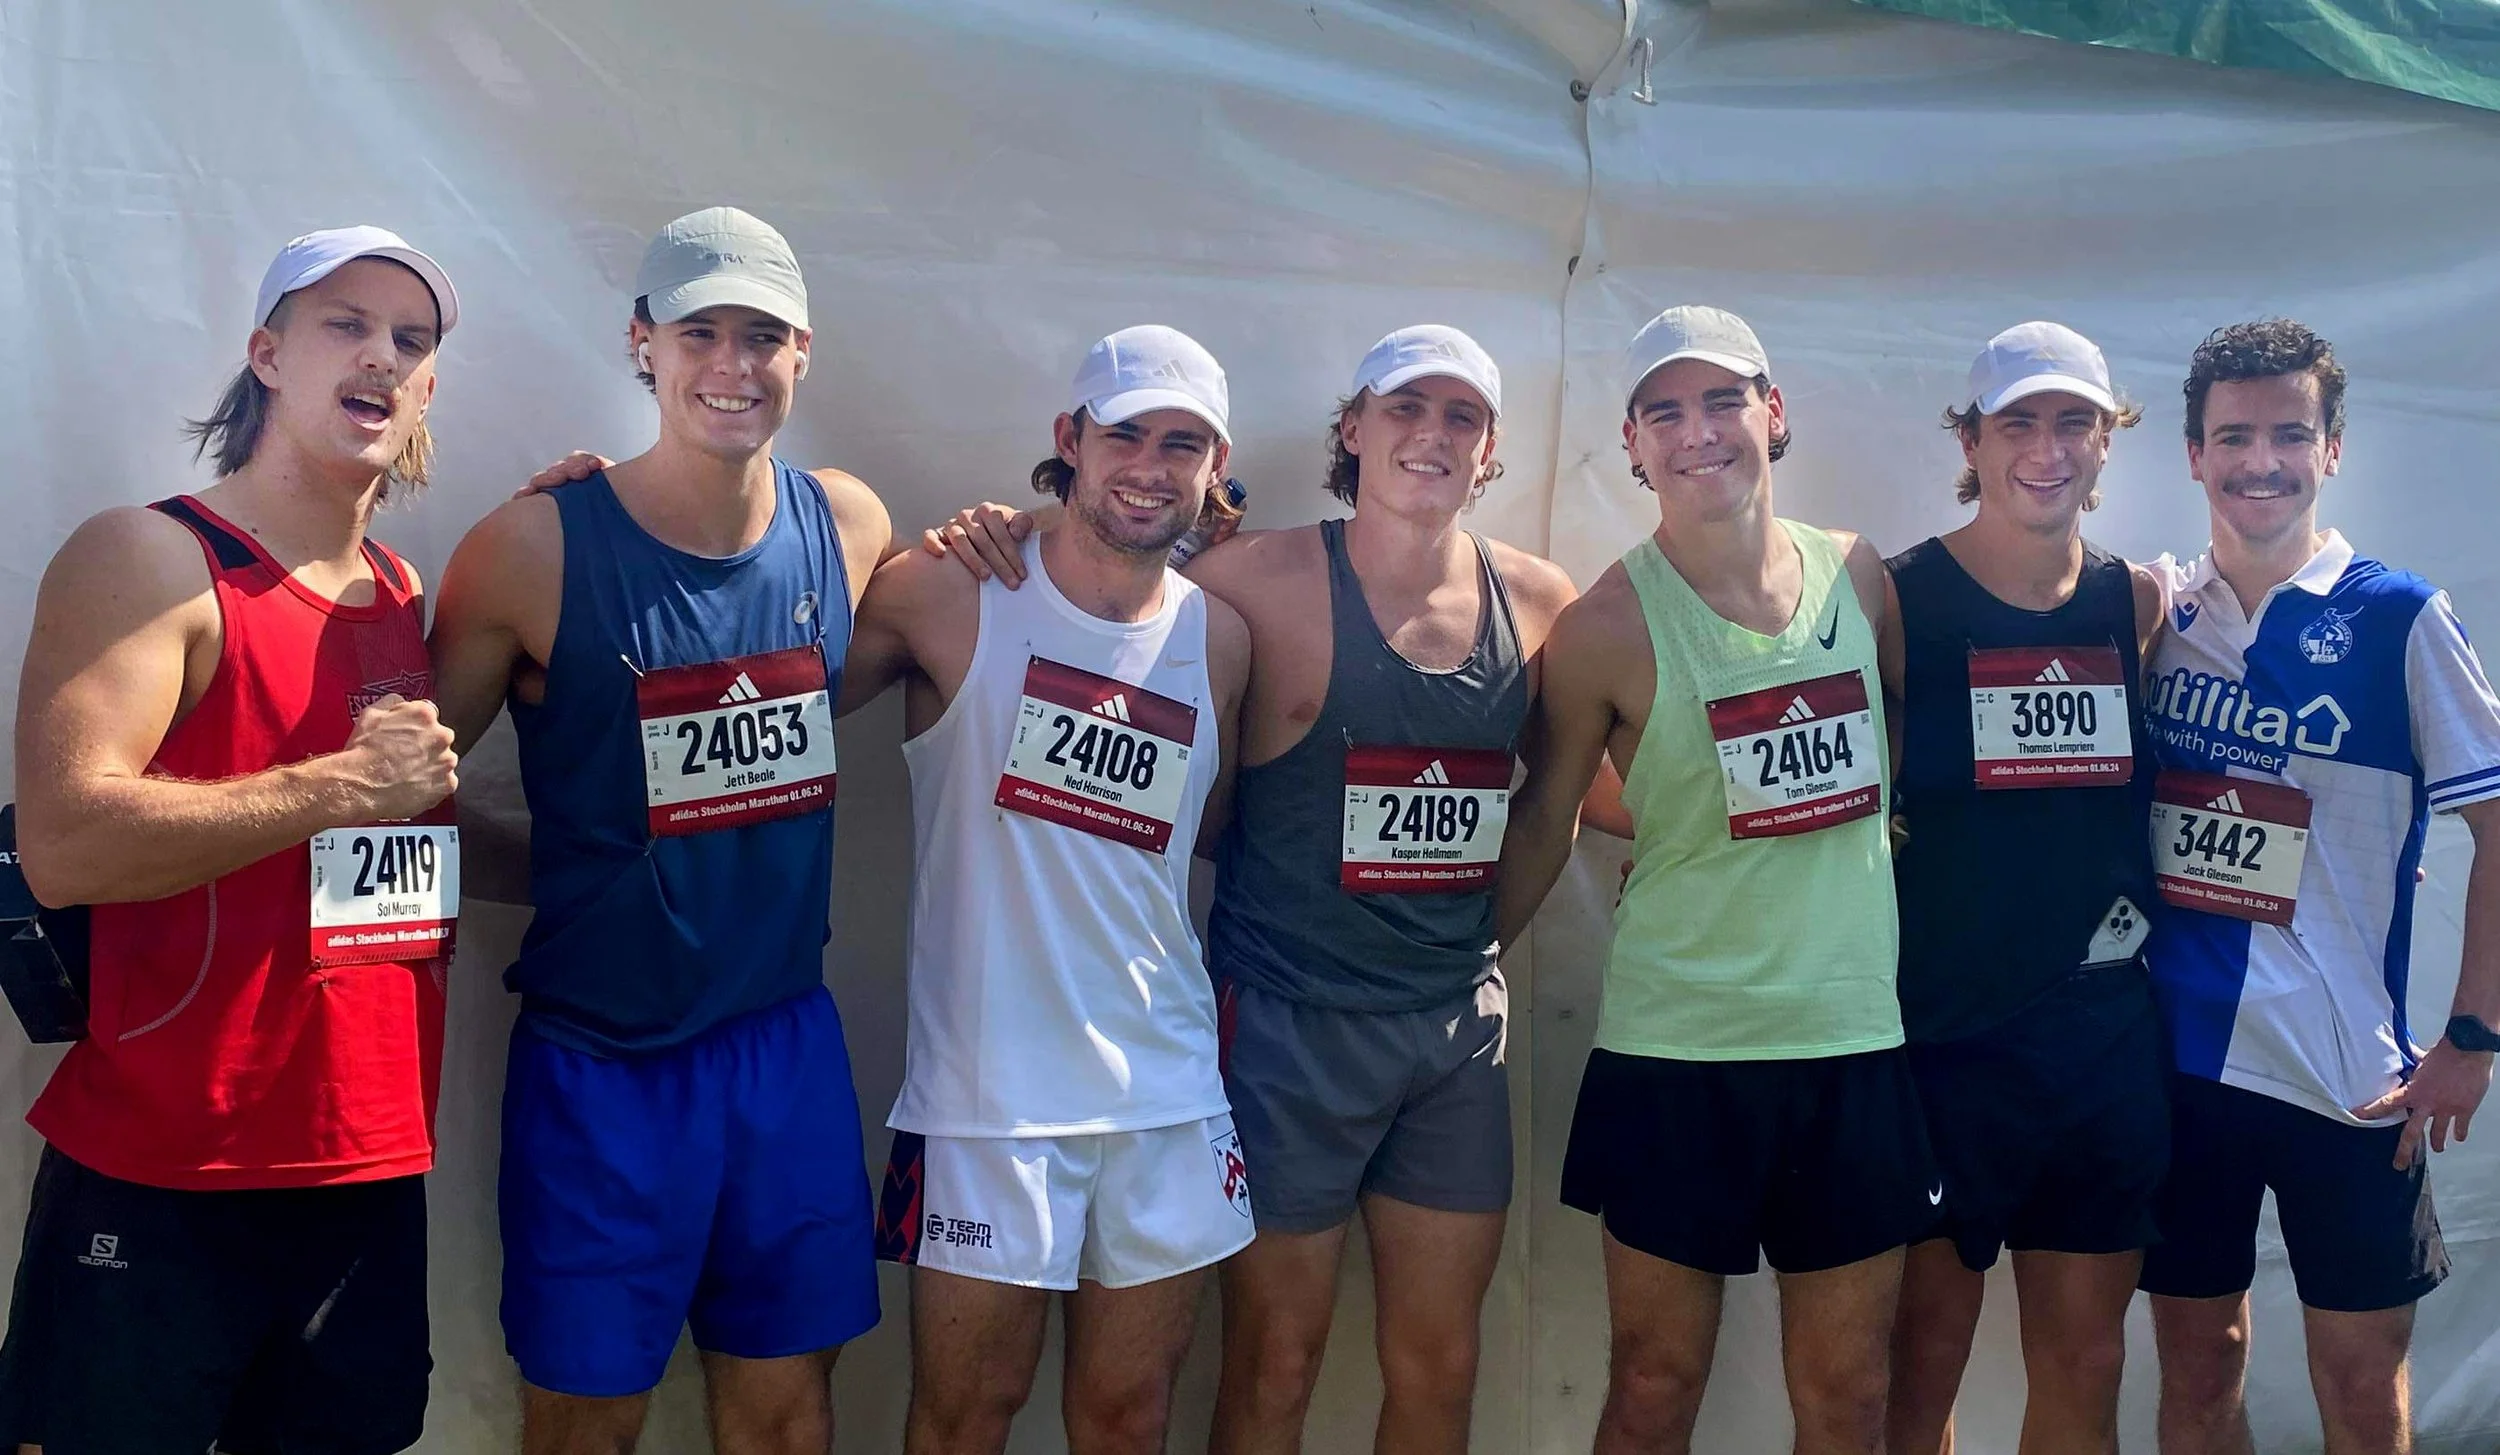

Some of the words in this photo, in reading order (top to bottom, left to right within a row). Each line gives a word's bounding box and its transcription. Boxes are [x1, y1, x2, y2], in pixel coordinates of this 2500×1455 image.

[1036, 707, 1044, 719] J
[2010, 690, 2097, 738] 3890
[2149, 672, 2289, 747] utilita
[663, 723, 670, 736] J
[676, 702, 809, 776] 24053
[1044, 714, 1158, 791] 24108
[1735, 743, 1742, 755] J
[1752, 721, 1854, 787] 24164
[2017, 742, 2053, 754] Thomas
[2054, 741, 2095, 755] Lempriere
[2164, 729, 2205, 752] with
[2209, 742, 2283, 771] power
[724, 774, 747, 789] Jett
[747, 768, 776, 786] Beale
[1990, 765, 2014, 776] adidas
[2015, 764, 2054, 775] Stockholm
[2055, 763, 2089, 774] Marathon
[2089, 762, 2119, 773] 01.06.24
[1063, 774, 1083, 792] Ned
[1083, 779, 1123, 804] Harrison
[1362, 792, 1369, 804] J
[1784, 786, 1804, 800] Tom
[1805, 779, 1839, 796] Gleeson
[669, 809, 699, 822] adidas
[700, 800, 748, 818] Stockholm
[748, 793, 789, 809] Marathon
[789, 784, 823, 802] 01.06.24
[1014, 787, 1041, 802] adidas
[1041, 793, 1082, 815] Stockholm
[1083, 806, 1120, 827] Marathon
[1120, 816, 1156, 837] 01.06.24
[1773, 809, 1813, 825] Stockholm
[1813, 801, 1845, 817] Marathon
[1378, 793, 1480, 843] 24189
[328, 837, 335, 851] J
[2173, 813, 2267, 872] 3442
[1391, 847, 1422, 862] Kasper
[351, 834, 435, 897] 24119
[1358, 867, 1383, 879] adidas
[1383, 868, 1421, 880] Stockholm
[1421, 869, 1455, 880] Marathon
[2183, 864, 2205, 878] Jack
[2206, 867, 2243, 885] Gleeson
[2166, 883, 2205, 899] Stockholm
[2205, 890, 2242, 906] Marathon
[2243, 897, 2279, 912] 01.06.24
[377, 902, 391, 918] Sol
[392, 901, 422, 917] Murray
[327, 933, 354, 948] adidas
[355, 930, 397, 946] Stockholm
[397, 928, 430, 943] Marathon
[945, 1231, 992, 1249] spirit
